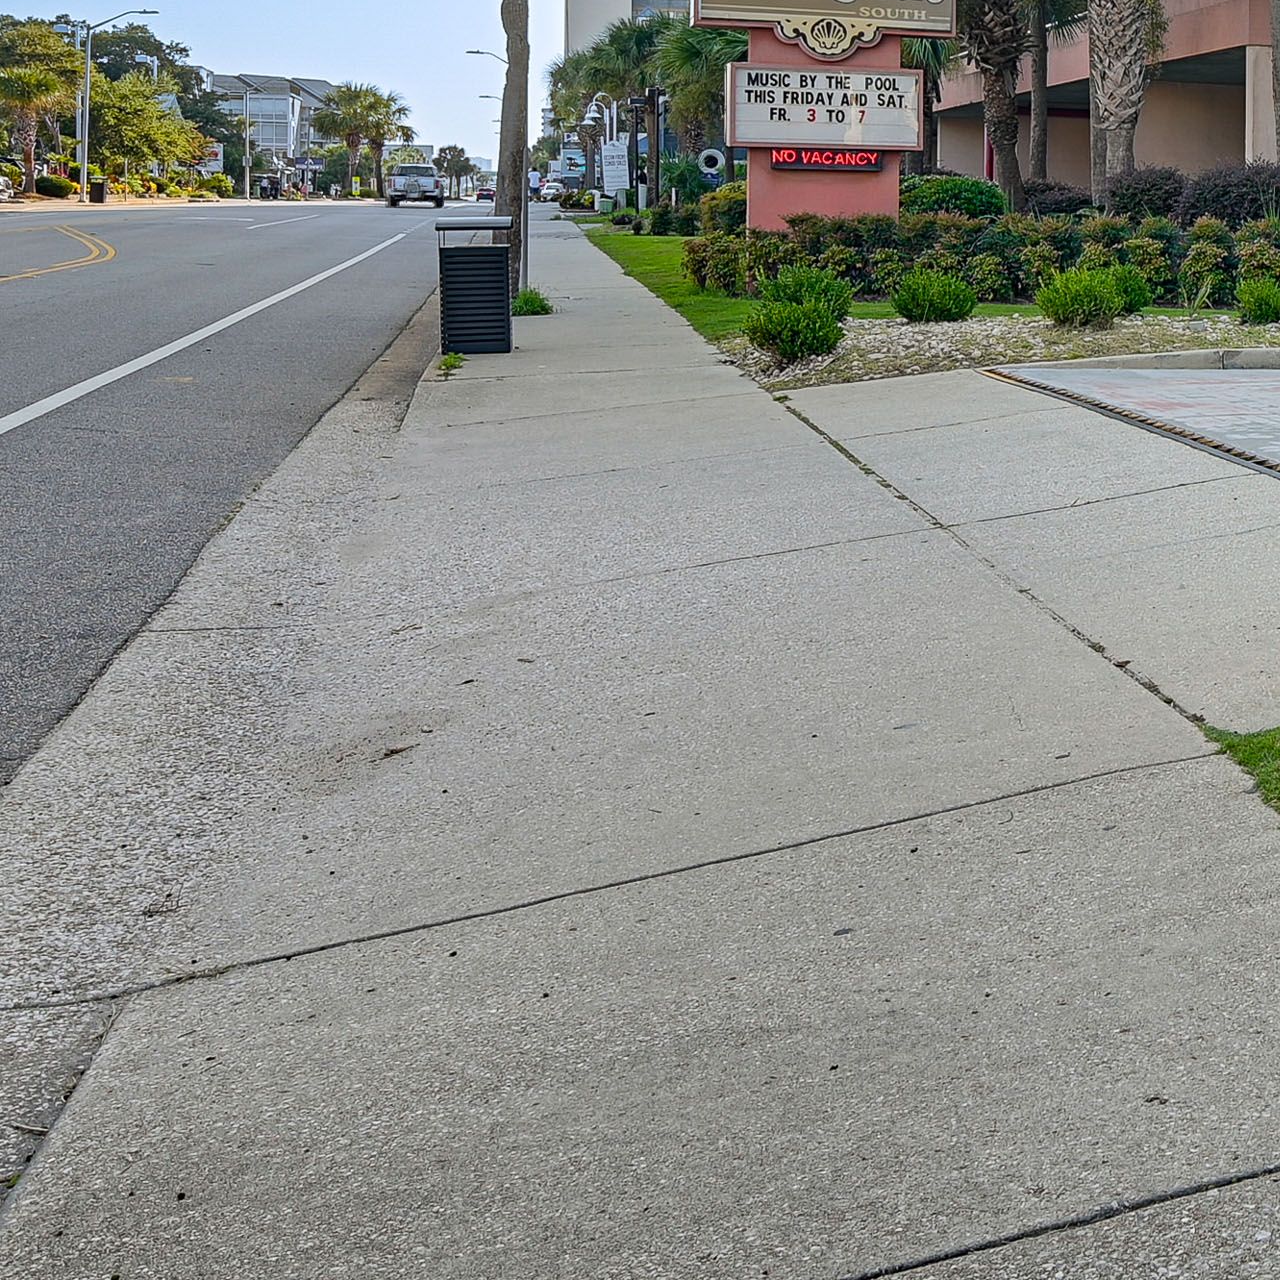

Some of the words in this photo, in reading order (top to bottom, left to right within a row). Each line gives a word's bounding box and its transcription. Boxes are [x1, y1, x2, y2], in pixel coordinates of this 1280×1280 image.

[859, 7, 928, 20] SOUTH
[747, 72, 791, 88] MUSIC
[800, 74, 817, 89] BY
[826, 76, 851, 90] THE
[865, 77, 899, 91] POOL
[745, 90, 776, 104] THIS
[783, 91, 834, 106] FRIDAY
[841, 93, 868, 107] AND
[877, 94, 908, 109] SAT.
[770, 107, 791, 122] FR.
[807, 108, 817, 122] 3
[826, 109, 845, 123] TO
[858, 110, 866, 123] 7
[772, 149, 797, 163] NO
[802, 150, 878, 165] VACANCY
